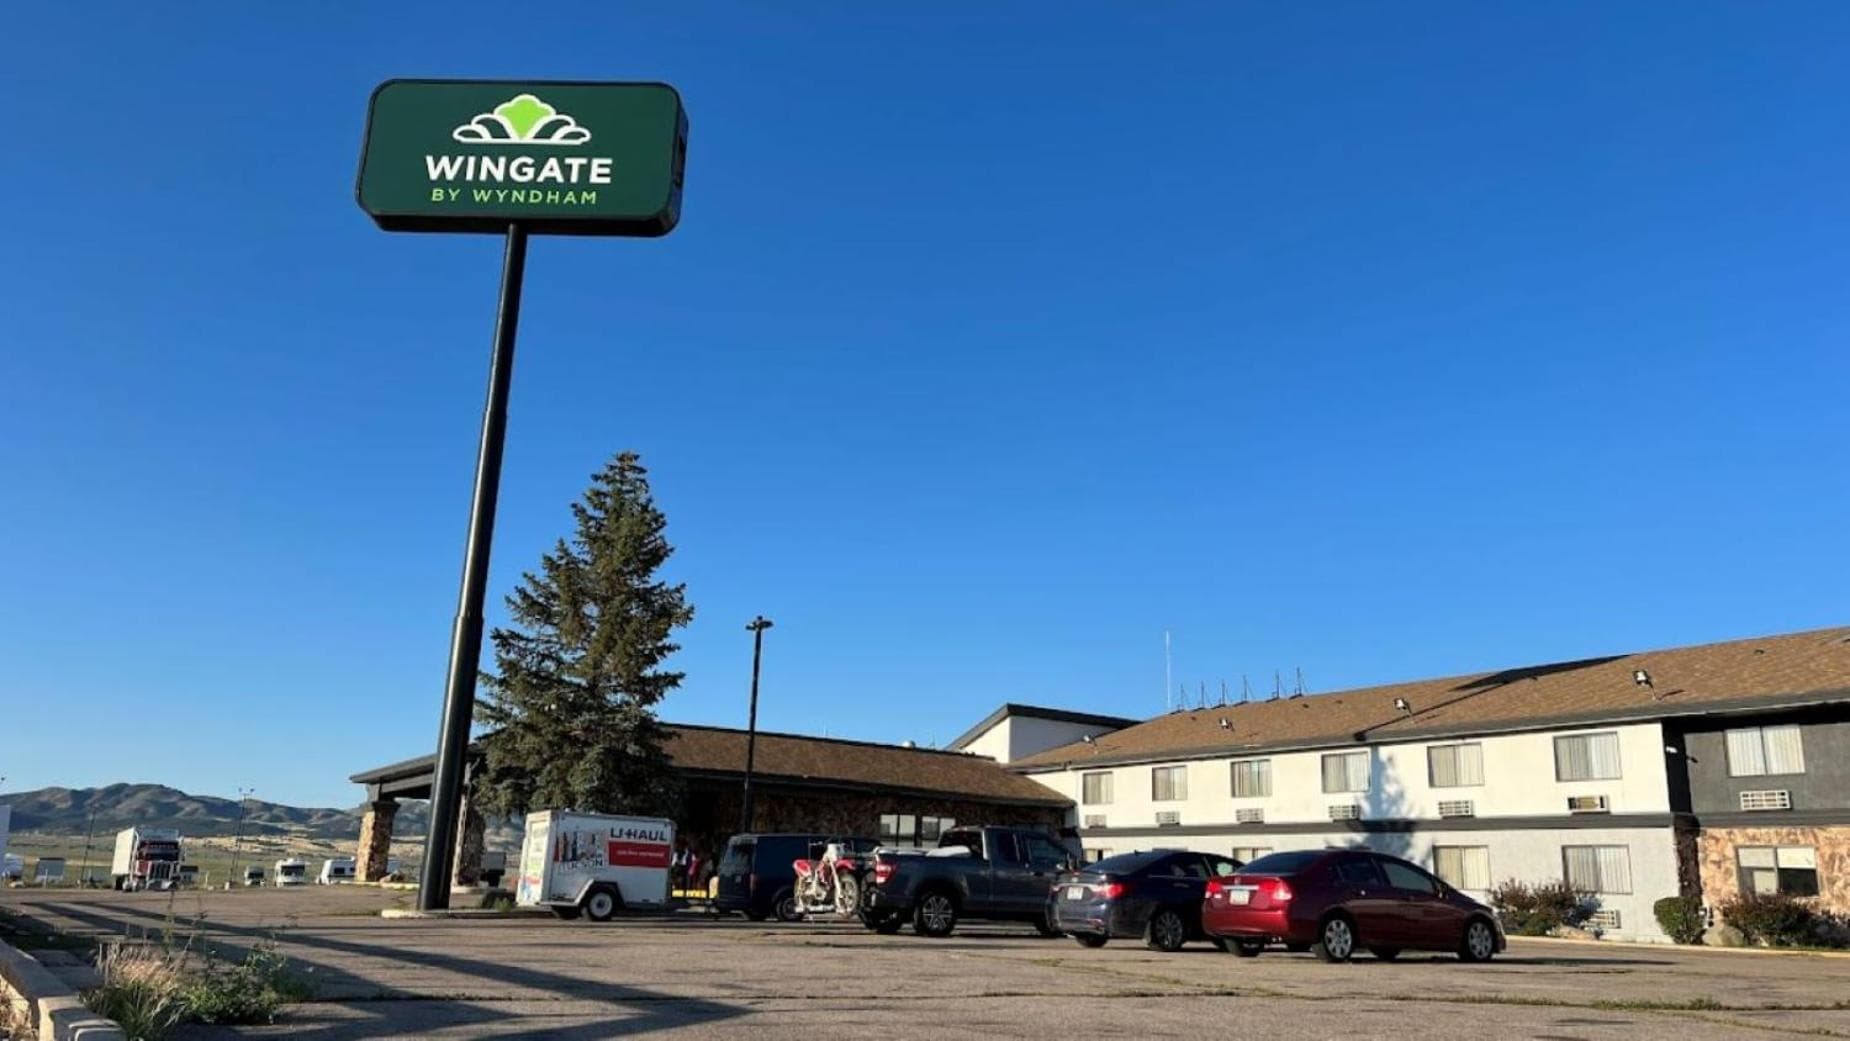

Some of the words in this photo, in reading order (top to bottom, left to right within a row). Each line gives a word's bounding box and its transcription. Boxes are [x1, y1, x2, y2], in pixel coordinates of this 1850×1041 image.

[425, 155, 614, 184] WINGATE
[430, 188, 461, 202] BY
[472, 189, 597, 205] WYNDHAM
